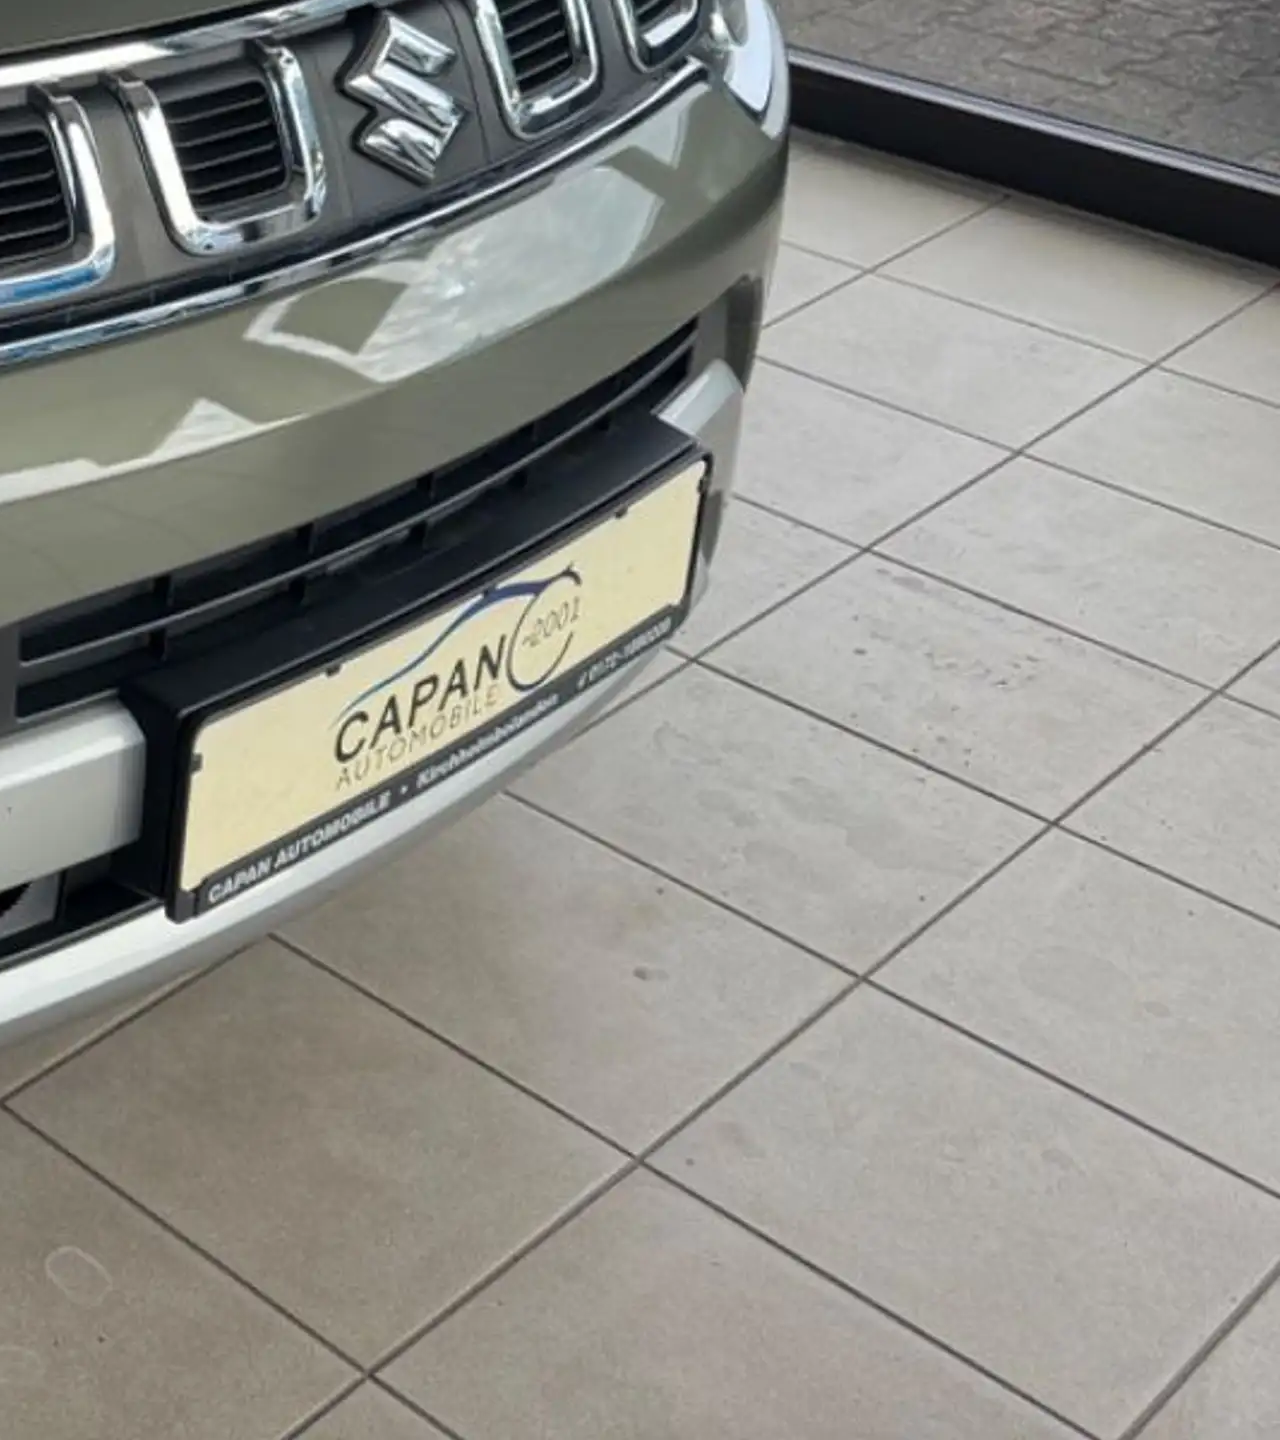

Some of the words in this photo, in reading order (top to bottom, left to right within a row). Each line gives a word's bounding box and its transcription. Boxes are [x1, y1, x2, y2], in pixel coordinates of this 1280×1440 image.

[333, 633, 507, 764] CAPAN
[336, 682, 500, 792] AUTOMOBILE
[207, 857, 273, 905] CAPAN
[273, 789, 392, 869] AUTOMOBILE
